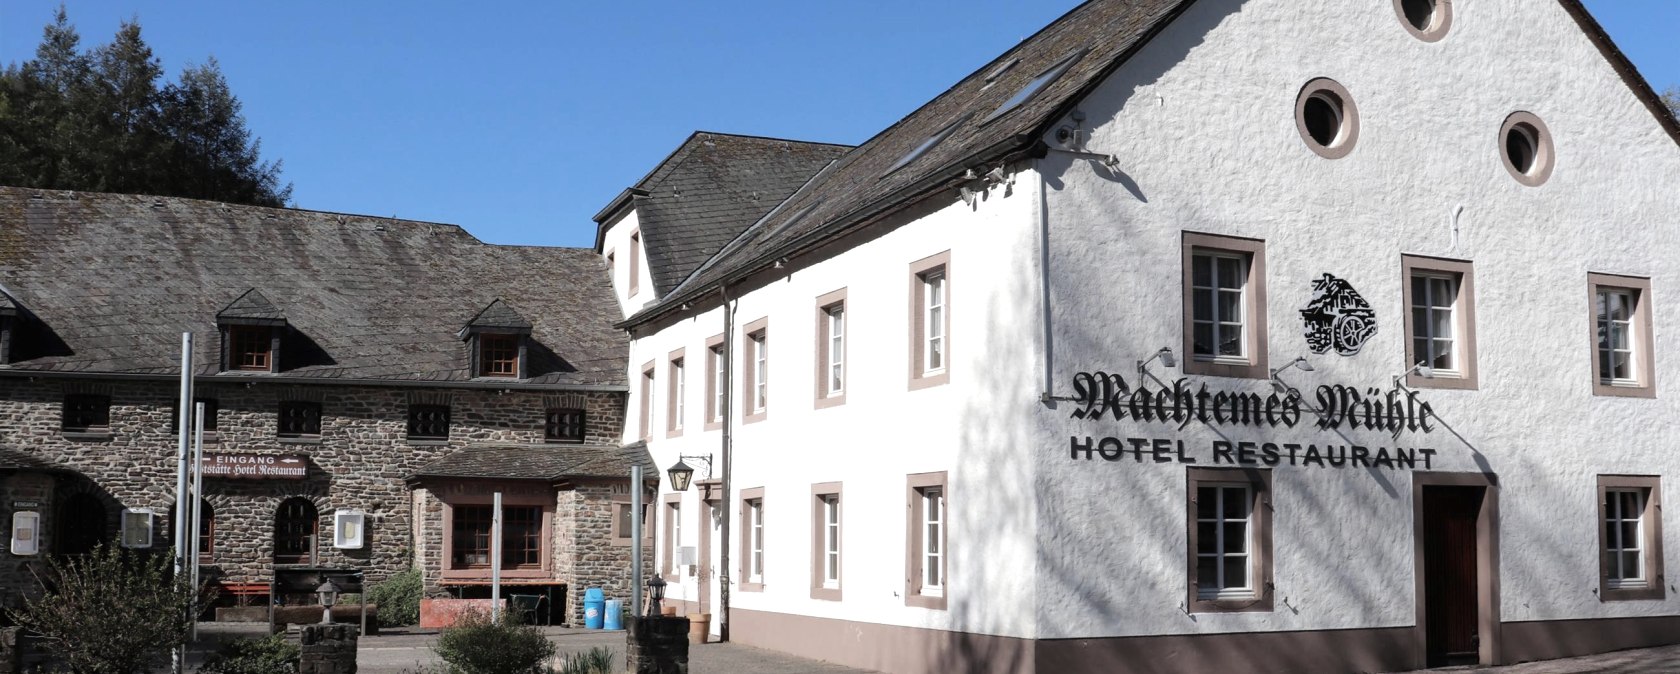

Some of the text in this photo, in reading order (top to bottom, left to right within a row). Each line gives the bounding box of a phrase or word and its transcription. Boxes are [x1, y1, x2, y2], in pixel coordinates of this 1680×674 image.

[1069, 371, 1435, 441] Machtemes Mühle
[216, 455, 275, 464] EINGANG
[1070, 436, 1437, 470] HOTEL RESTAURANT
[189, 463, 306, 476] tstätte Hotel Restaurant
